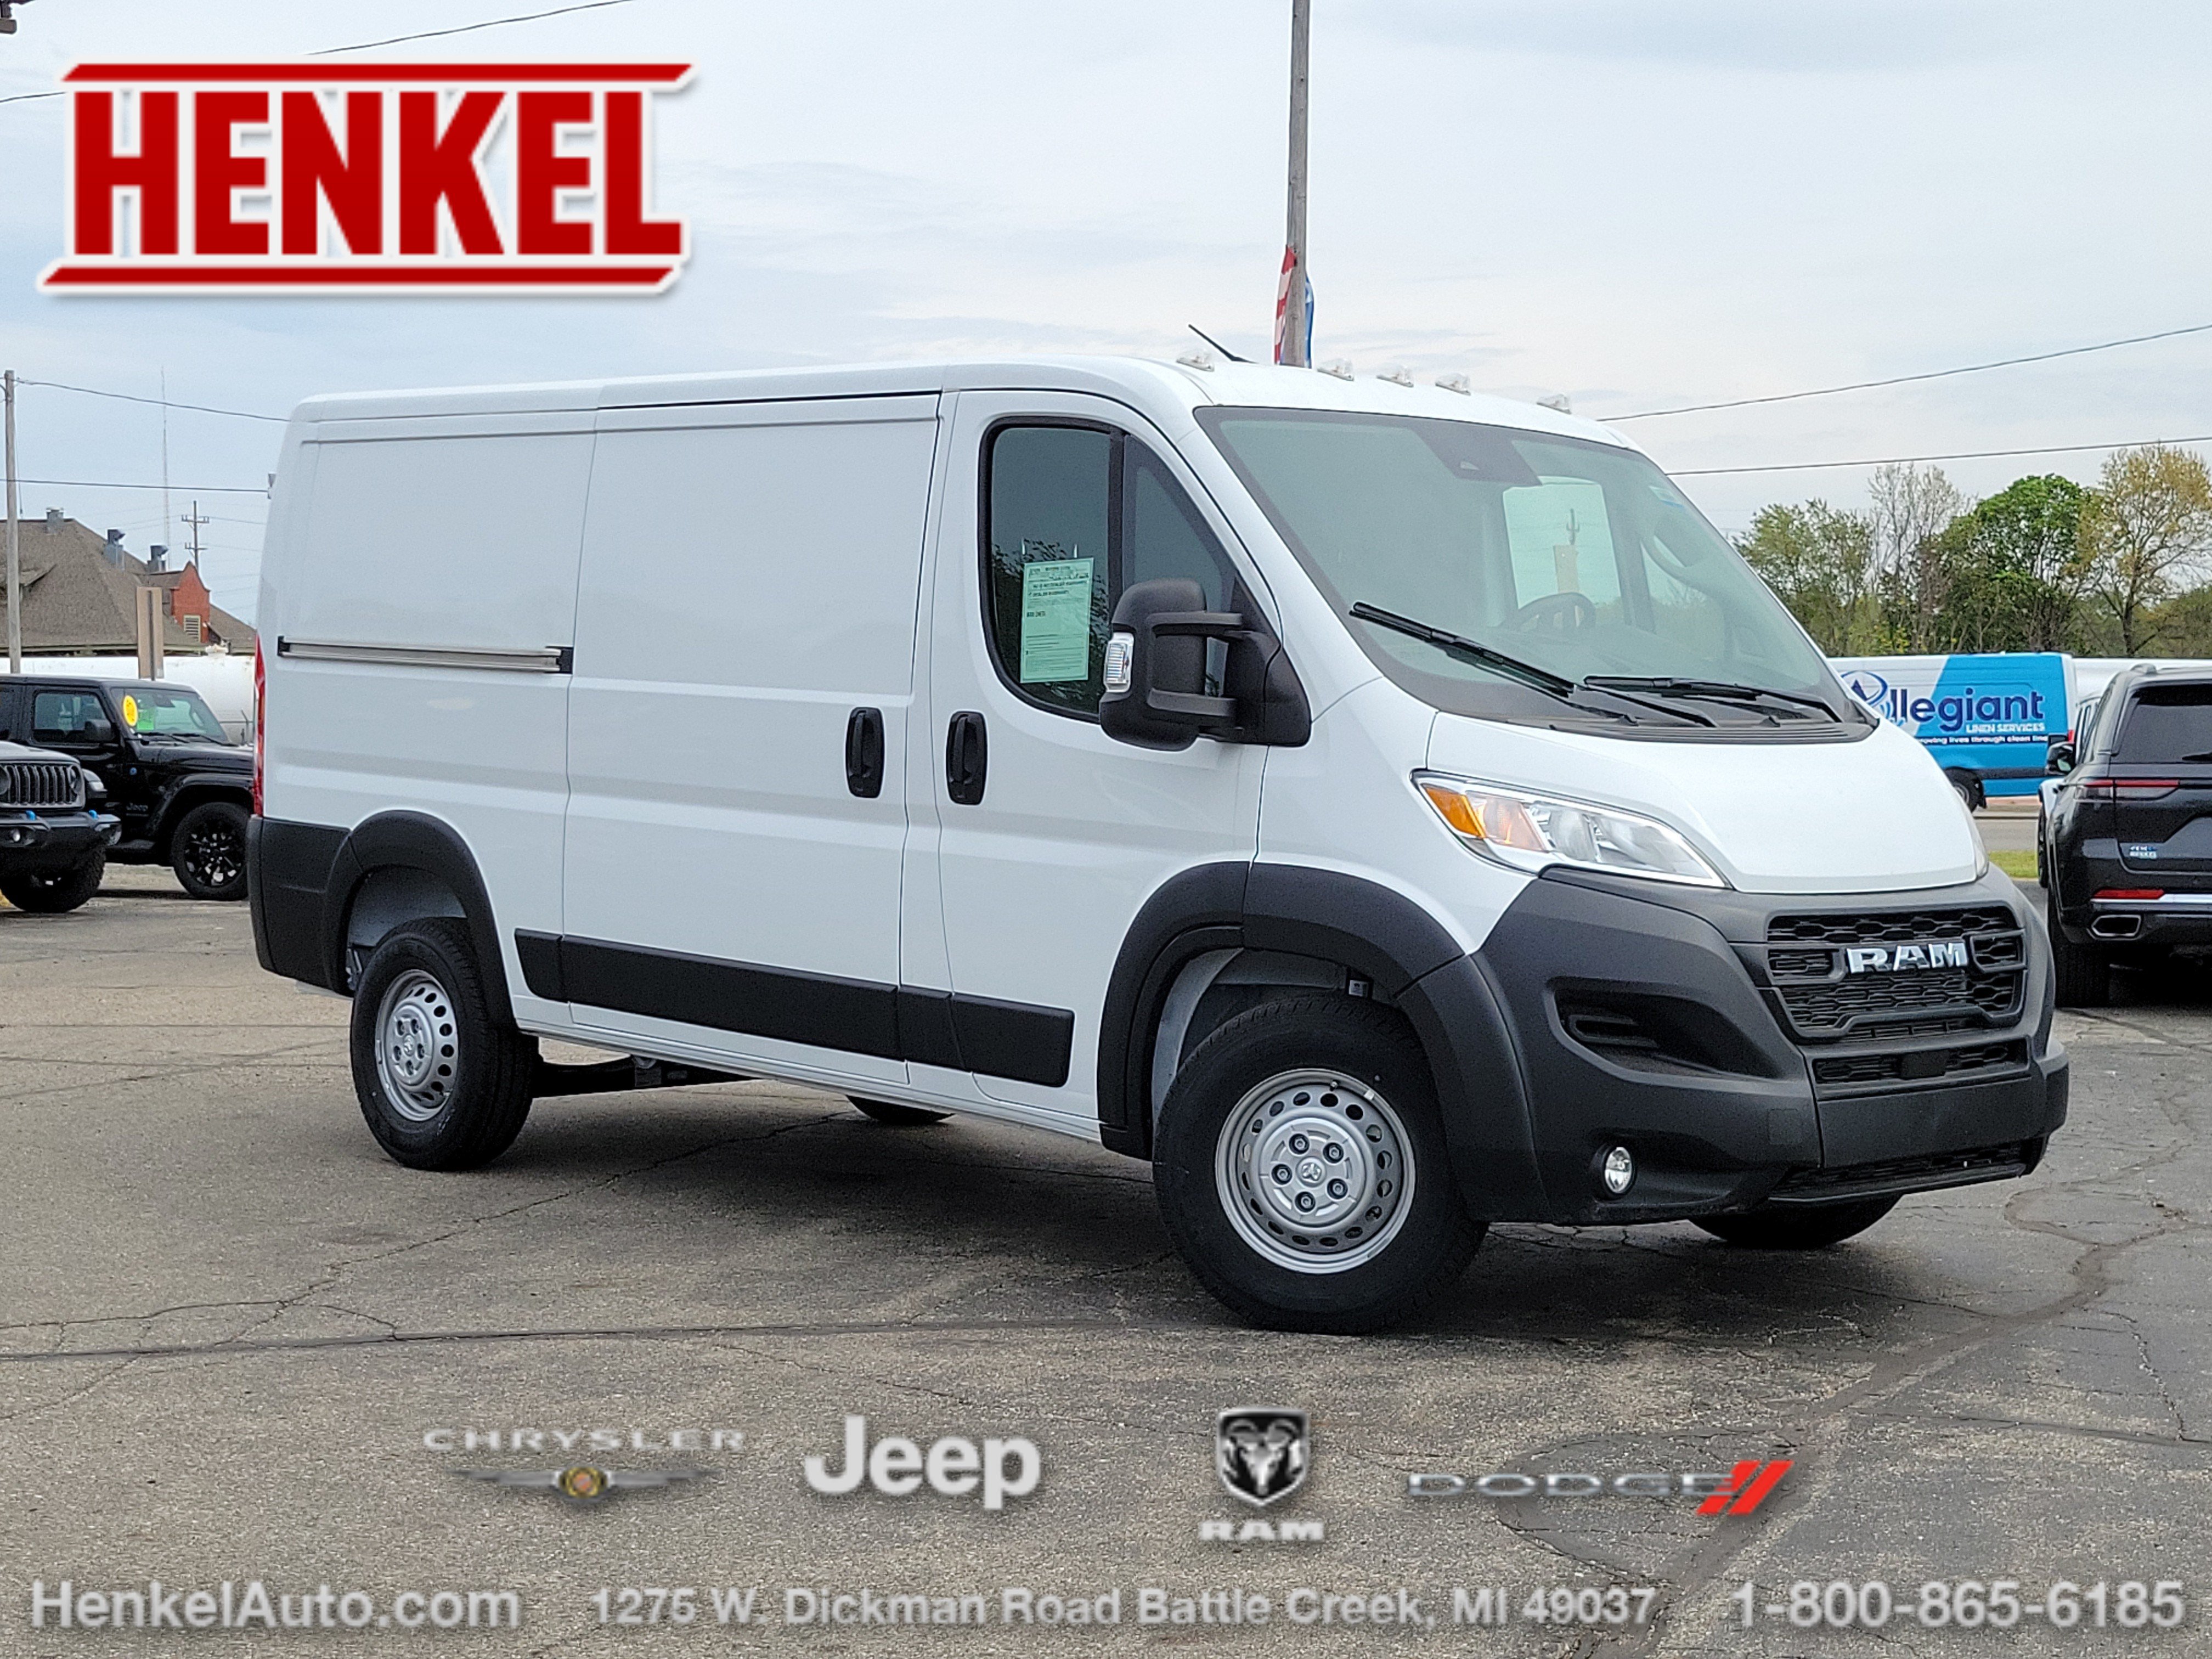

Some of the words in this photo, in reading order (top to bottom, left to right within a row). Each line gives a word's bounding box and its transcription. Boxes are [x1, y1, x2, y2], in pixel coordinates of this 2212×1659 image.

[1997, 723, 2045, 732] SERVICES
[1971, 735, 2006, 744] through
[1847, 943, 1968, 974] RAM
